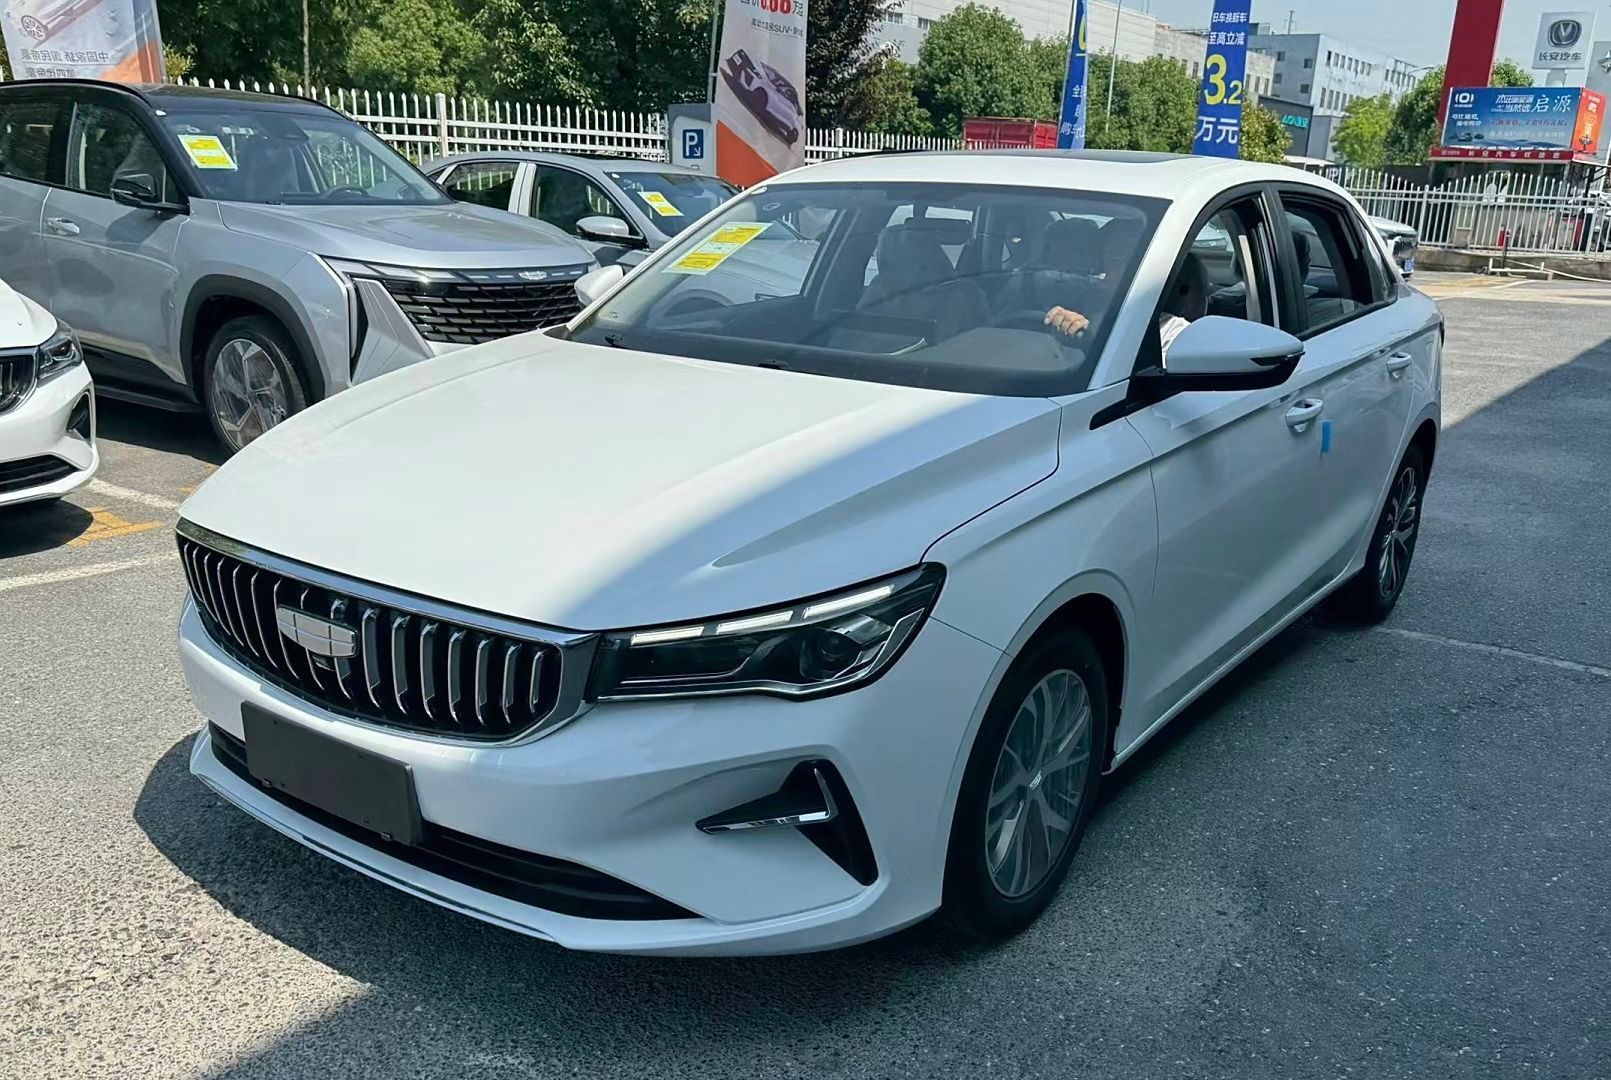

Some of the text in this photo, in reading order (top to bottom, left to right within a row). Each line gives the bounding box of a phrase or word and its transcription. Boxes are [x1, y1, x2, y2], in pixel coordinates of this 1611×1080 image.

[1208, 31, 1246, 46] 至高立减
[1538, 52, 1583, 62] 长安汽车
[1194, 116, 1240, 144] 万元
[685, 131, 698, 156] P
